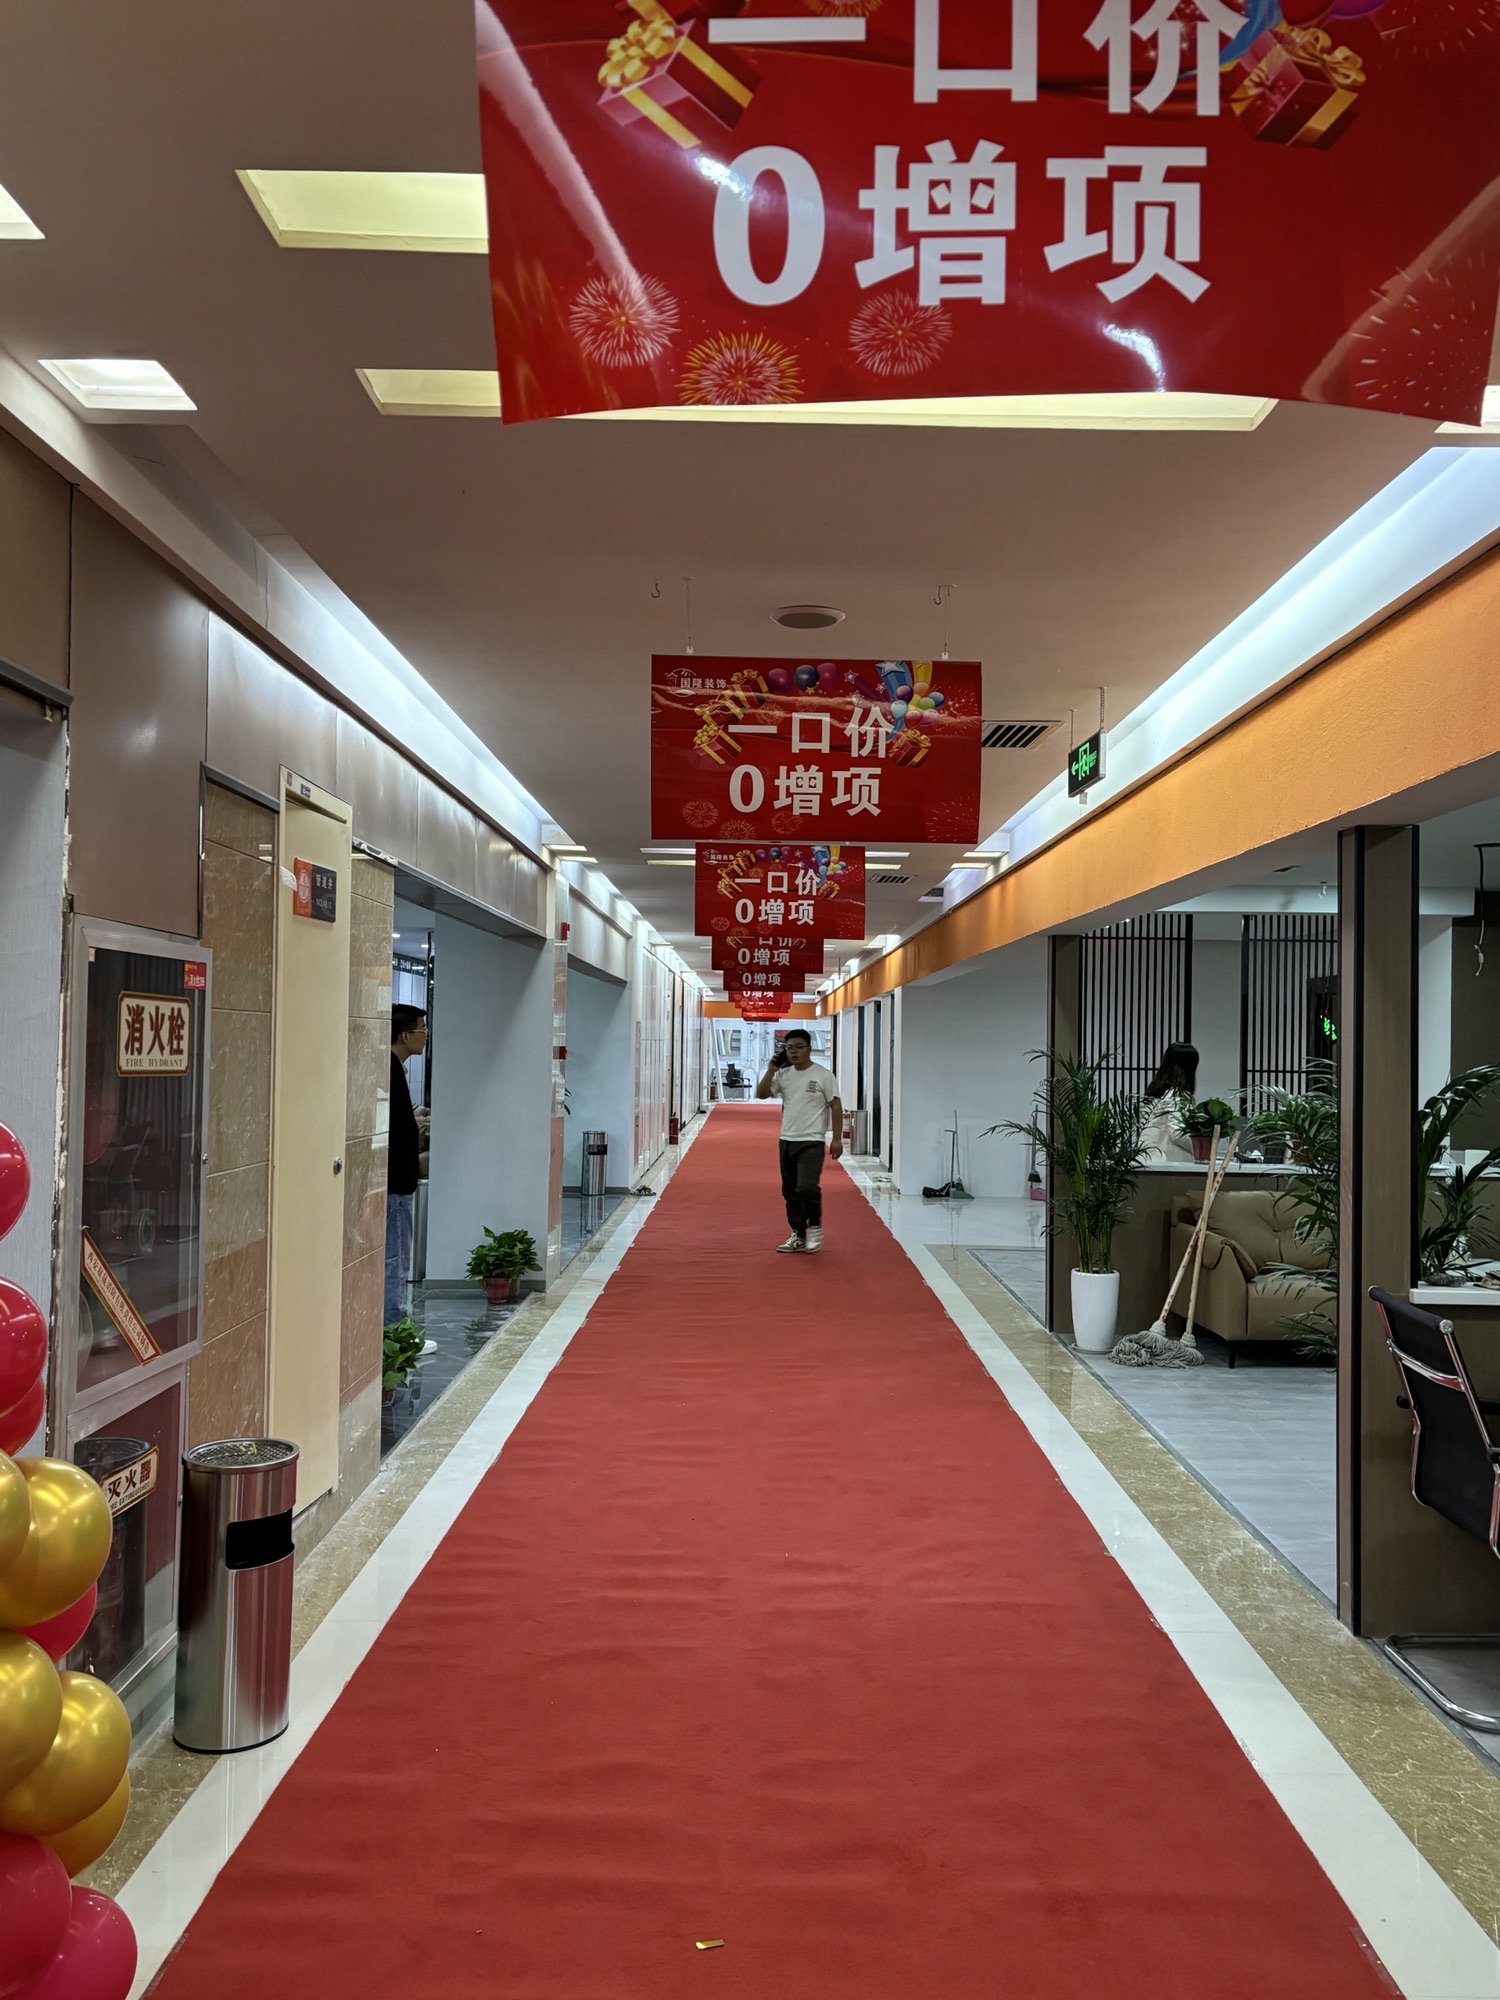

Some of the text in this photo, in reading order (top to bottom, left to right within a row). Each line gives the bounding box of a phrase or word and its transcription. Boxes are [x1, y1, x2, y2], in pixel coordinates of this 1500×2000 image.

[708, 0, 1250, 116] 一口价
[713, 139, 1211, 306] 0增项
[680, 678, 727, 689] 国隆装饰
[728, 707, 894, 758] 一口价
[729, 764, 882, 817] 0增项
[735, 868, 821, 896] 一口价
[735, 898, 815, 925] 0增项
[737, 947, 791, 966] 0增项
[742, 972, 781, 986] 0增项
[124, 1004, 186, 1057] 消火栓
[126, 1058, 184, 1068] FIRE HYDRANT
[107, 1458, 152, 1503] 灭火器
